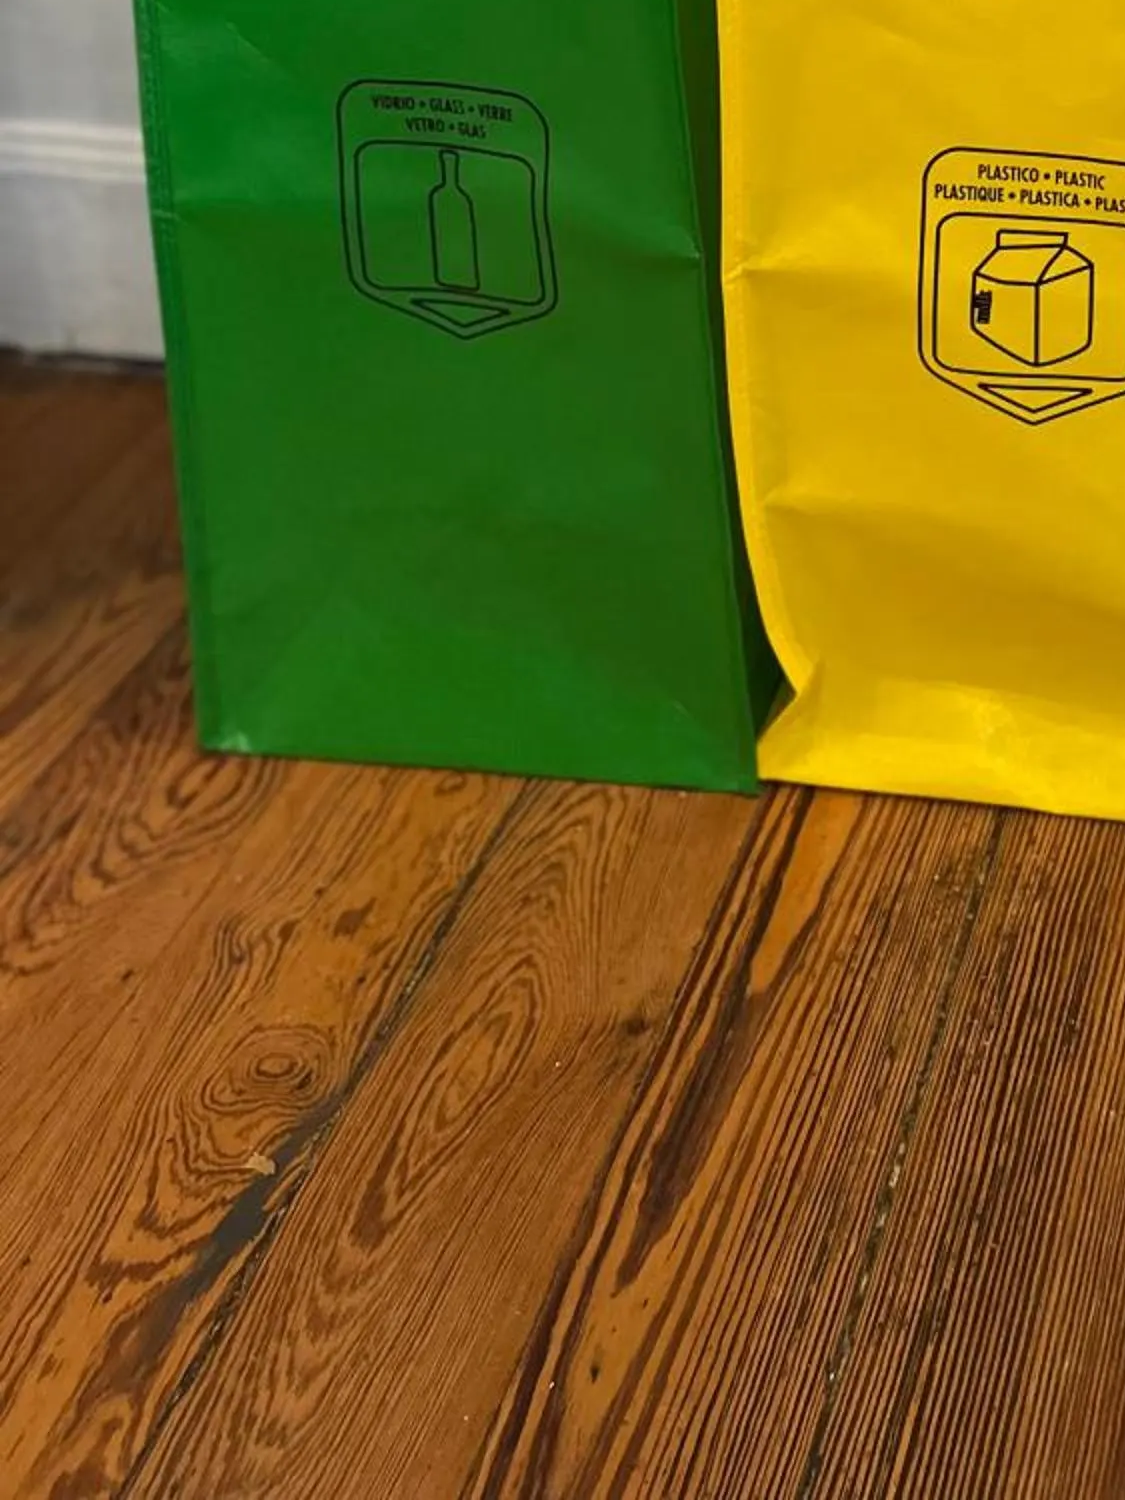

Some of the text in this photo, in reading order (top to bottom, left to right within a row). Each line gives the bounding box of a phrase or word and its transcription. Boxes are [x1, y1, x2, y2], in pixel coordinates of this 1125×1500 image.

[429, 98, 465, 115] GLASS
[405, 117, 487, 139] VETRO GLAS
[977, 163, 1105, 190] PLASTICO PLASTIC
[934, 183, 1004, 203] PLASTIQUE
[1019, 189, 1080, 208] PLASTICA
